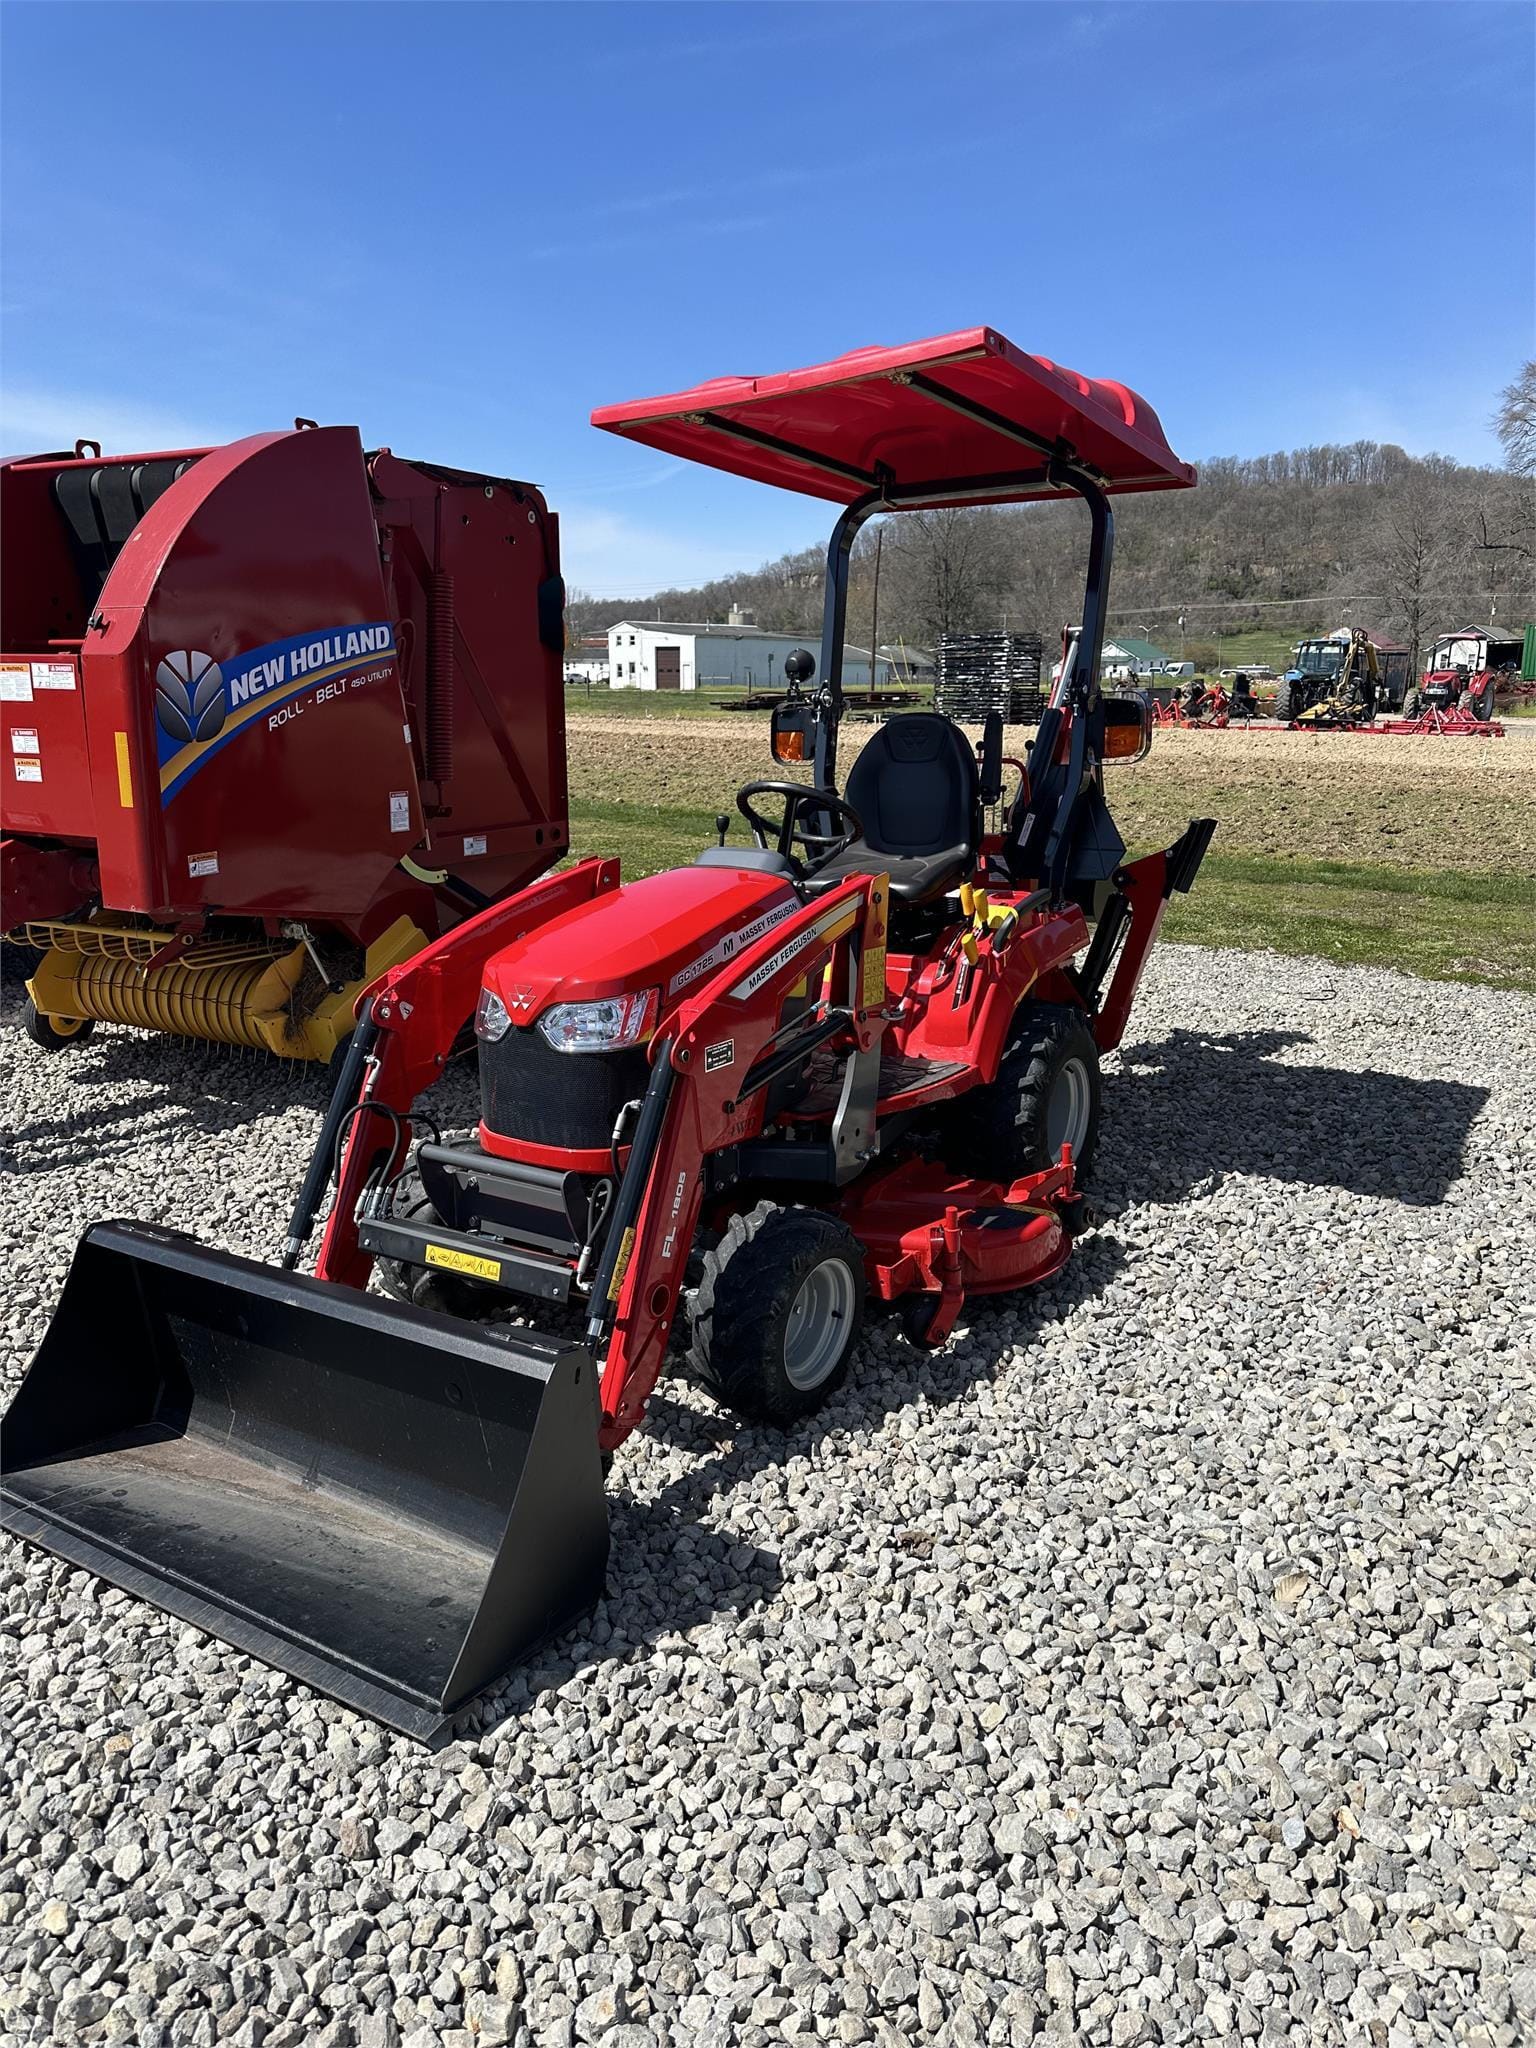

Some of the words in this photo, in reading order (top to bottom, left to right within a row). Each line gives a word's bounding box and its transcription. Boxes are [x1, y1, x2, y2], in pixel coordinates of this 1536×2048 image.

[230, 655, 285, 706] NEW
[290, 626, 390, 676] HOLLAND
[268, 702, 304, 731] ROLL
[316, 678, 347, 704] BELT
[351, 676, 366, 688] 450
[367, 667, 393, 682] UTILITY
[738, 922, 766, 944] MASSEY
[767, 902, 798, 926] FERGUSON
[748, 957, 779, 990] MASSEY
[780, 927, 818, 962] FERGUSON
[662, 1226, 677, 1258] FL
[671, 1171, 686, 1219] 1805
